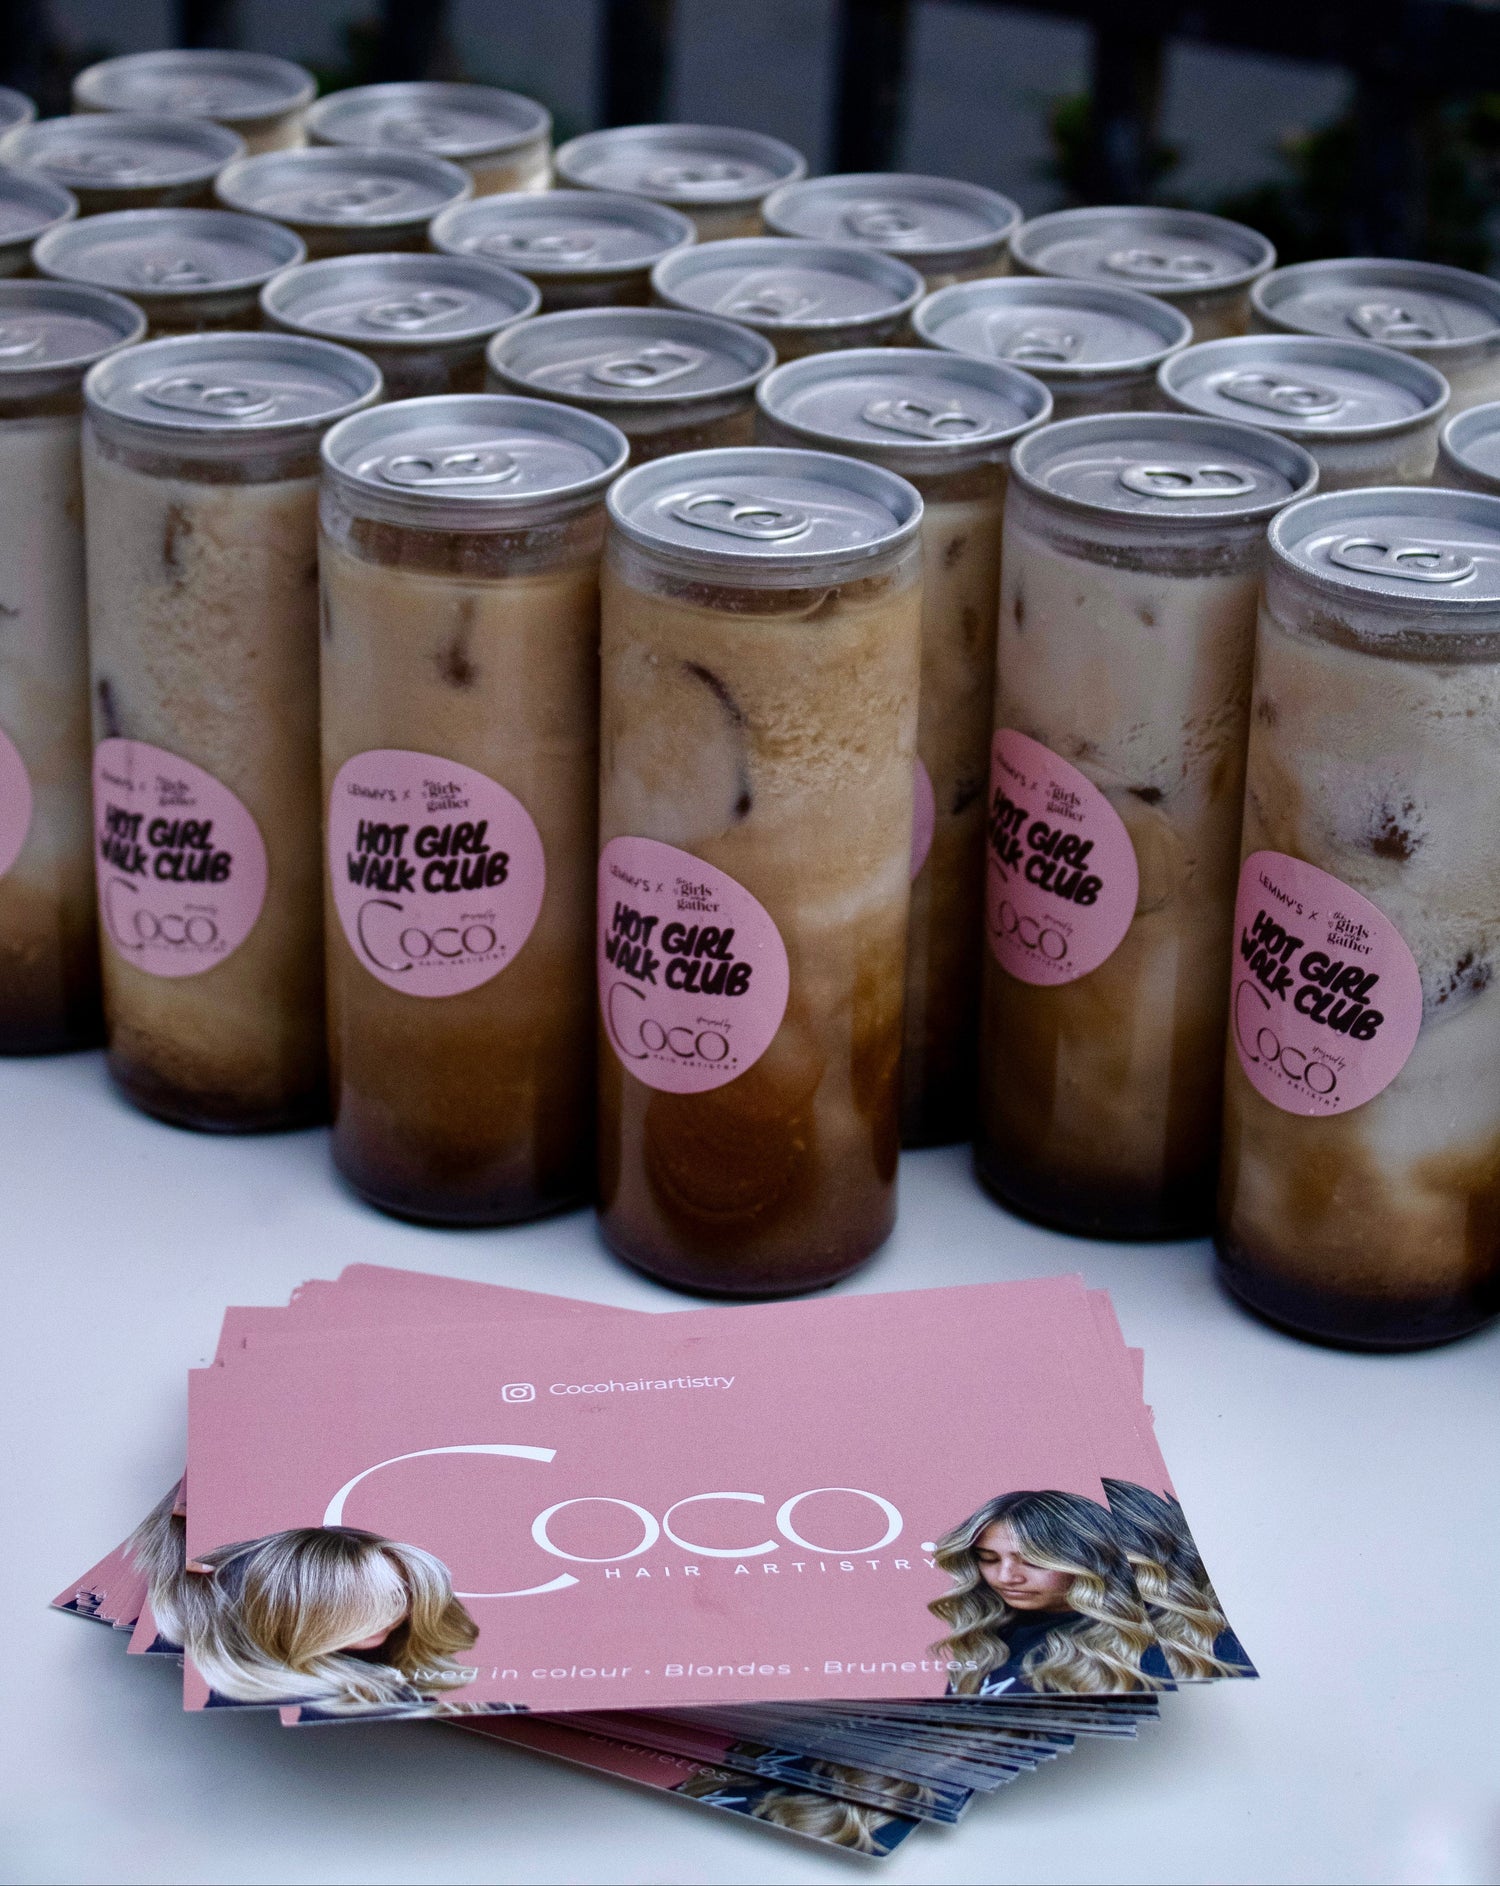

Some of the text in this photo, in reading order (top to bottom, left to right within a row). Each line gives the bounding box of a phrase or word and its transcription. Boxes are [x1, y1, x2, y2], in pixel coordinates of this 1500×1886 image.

[147, 817, 215, 850] GIRL
[356, 818, 490, 859] HOT GIRL
[1026, 821, 1094, 871] GIRL
[153, 850, 233, 882] CLUB
[347, 851, 510, 893] WALK CLUB
[989, 820, 1103, 906] ALK CLUB
[677, 899, 720, 912] gather
[681, 882, 712, 897] girls
[1259, 871, 1303, 915] LEMMY'S
[613, 901, 735, 961] HOT GIRL
[1327, 932, 1373, 955] gather
[1335, 919, 1369, 939] girls
[605, 928, 753, 997] WALK CLUB
[1251, 909, 1380, 1006] HOT GIRL
[1240, 927, 1384, 1041] WALK CLUB
[549, 1375, 735, 1396] Cocohairartistry
[604, 1558, 936, 1579] HAIR ARTISTRY
[491, 1666, 518, 1680] in
[531, 1665, 632, 1680] colour
[665, 1662, 791, 1677] Blondes
[824, 1659, 978, 1675] Brunettes
